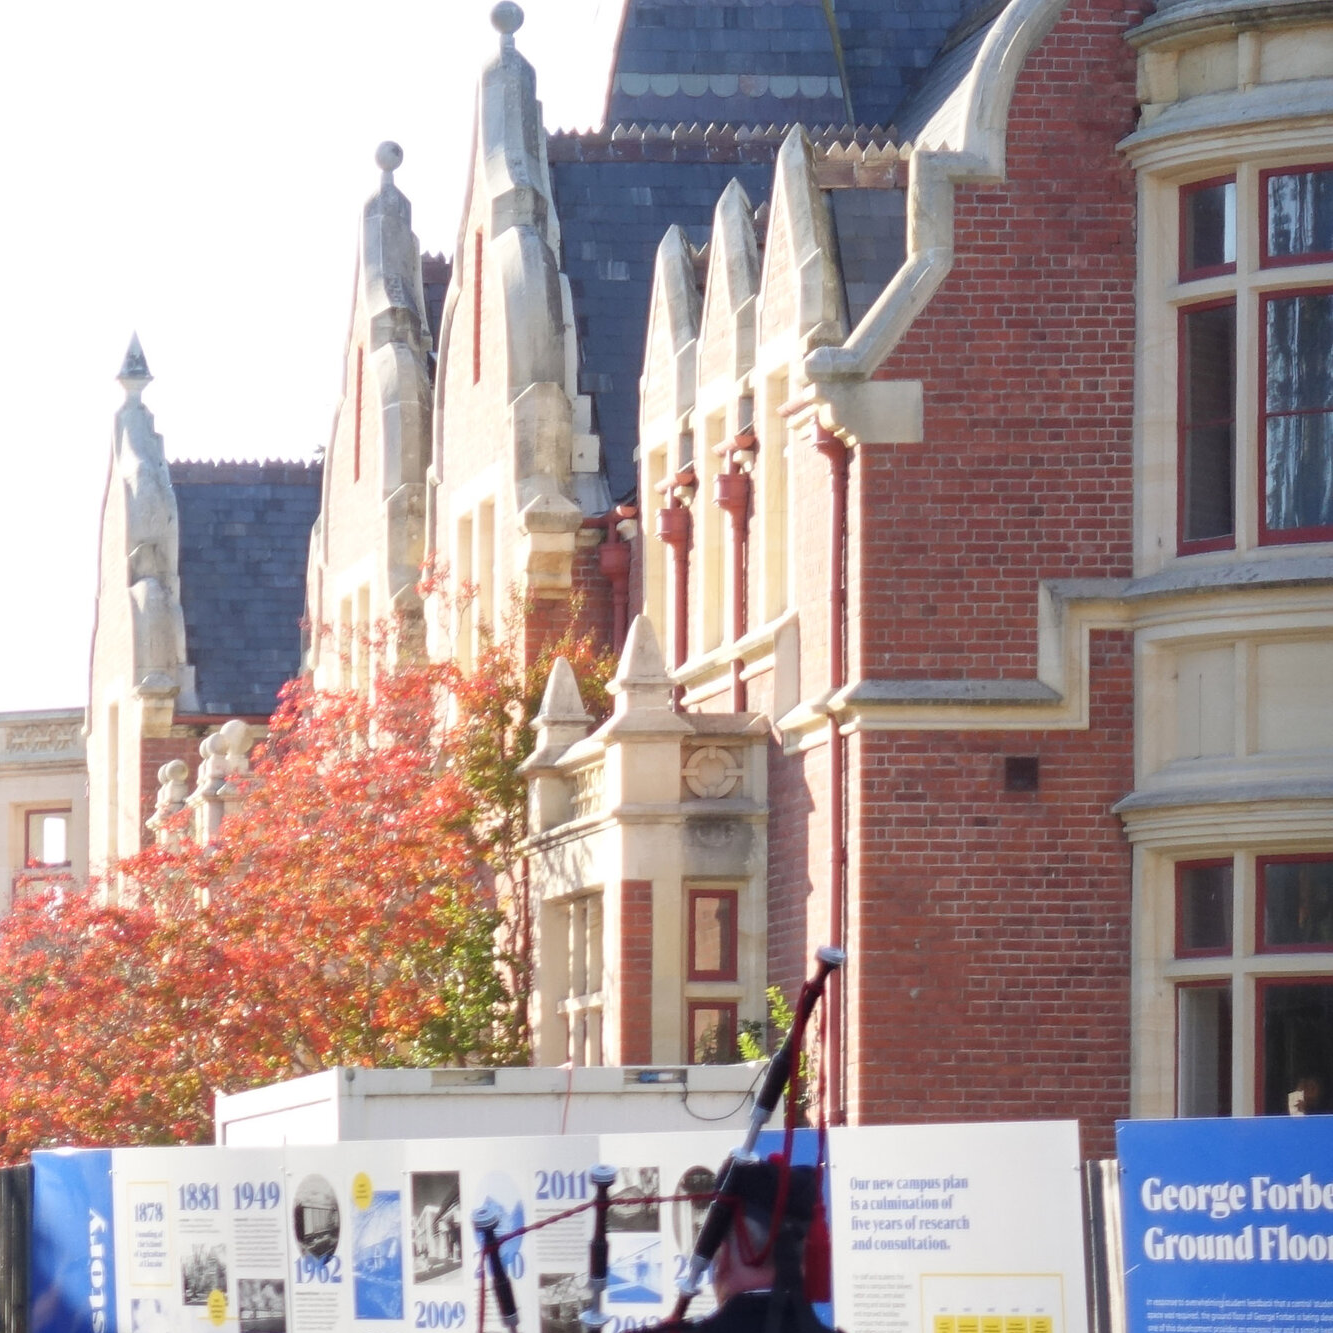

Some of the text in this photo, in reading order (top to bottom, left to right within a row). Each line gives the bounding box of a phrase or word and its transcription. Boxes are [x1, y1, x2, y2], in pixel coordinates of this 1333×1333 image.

[178, 1183, 220, 1211] 1881
[233, 1181, 281, 1210] 1949
[535, 1170, 587, 1200] 2011
[850, 1175, 968, 1192] Our new campus plan
[1141, 1174, 1333, 1219] George Forbe
[135, 1203, 163, 1222] 1878
[851, 1194, 954, 1210] is a culmination of
[851, 1215, 970, 1234] five years of research
[852, 1235, 950, 1250] and consultation.
[1144, 1224, 1254, 1261] Ground
[294, 1255, 343, 1284] 1962
[415, 1300, 466, 1329] 2009
